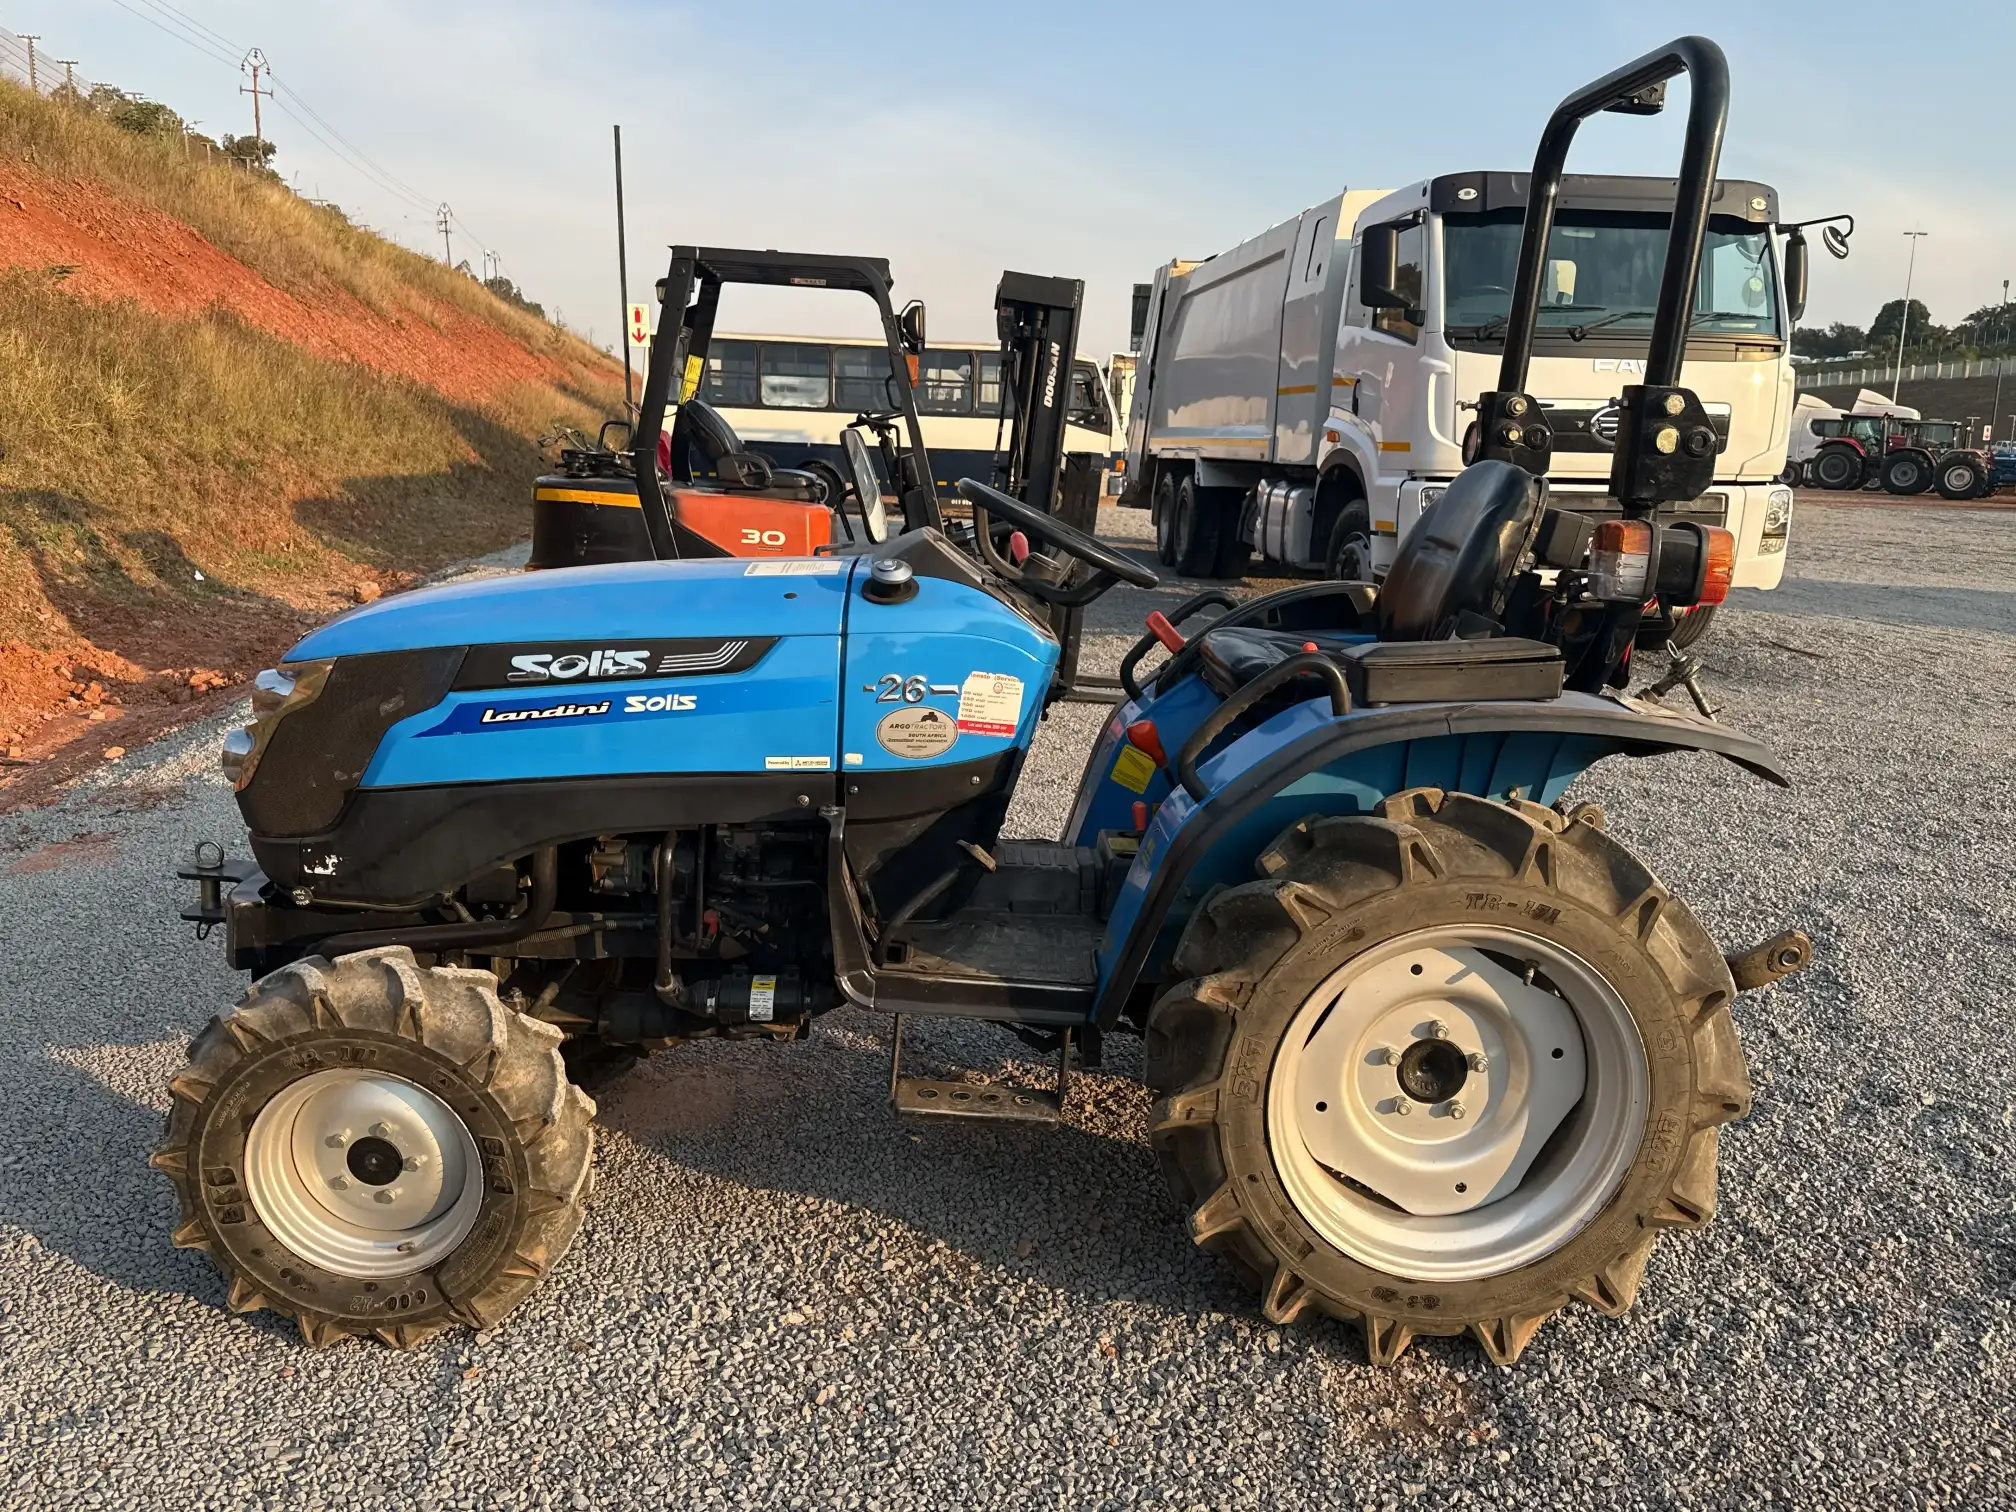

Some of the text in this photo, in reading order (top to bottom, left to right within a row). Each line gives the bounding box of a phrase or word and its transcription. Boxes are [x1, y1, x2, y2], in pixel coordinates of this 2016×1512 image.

[1043, 341, 1061, 408] DOOSAN
[741, 528, 786, 546] 30
[482, 702, 611, 724] Landini
